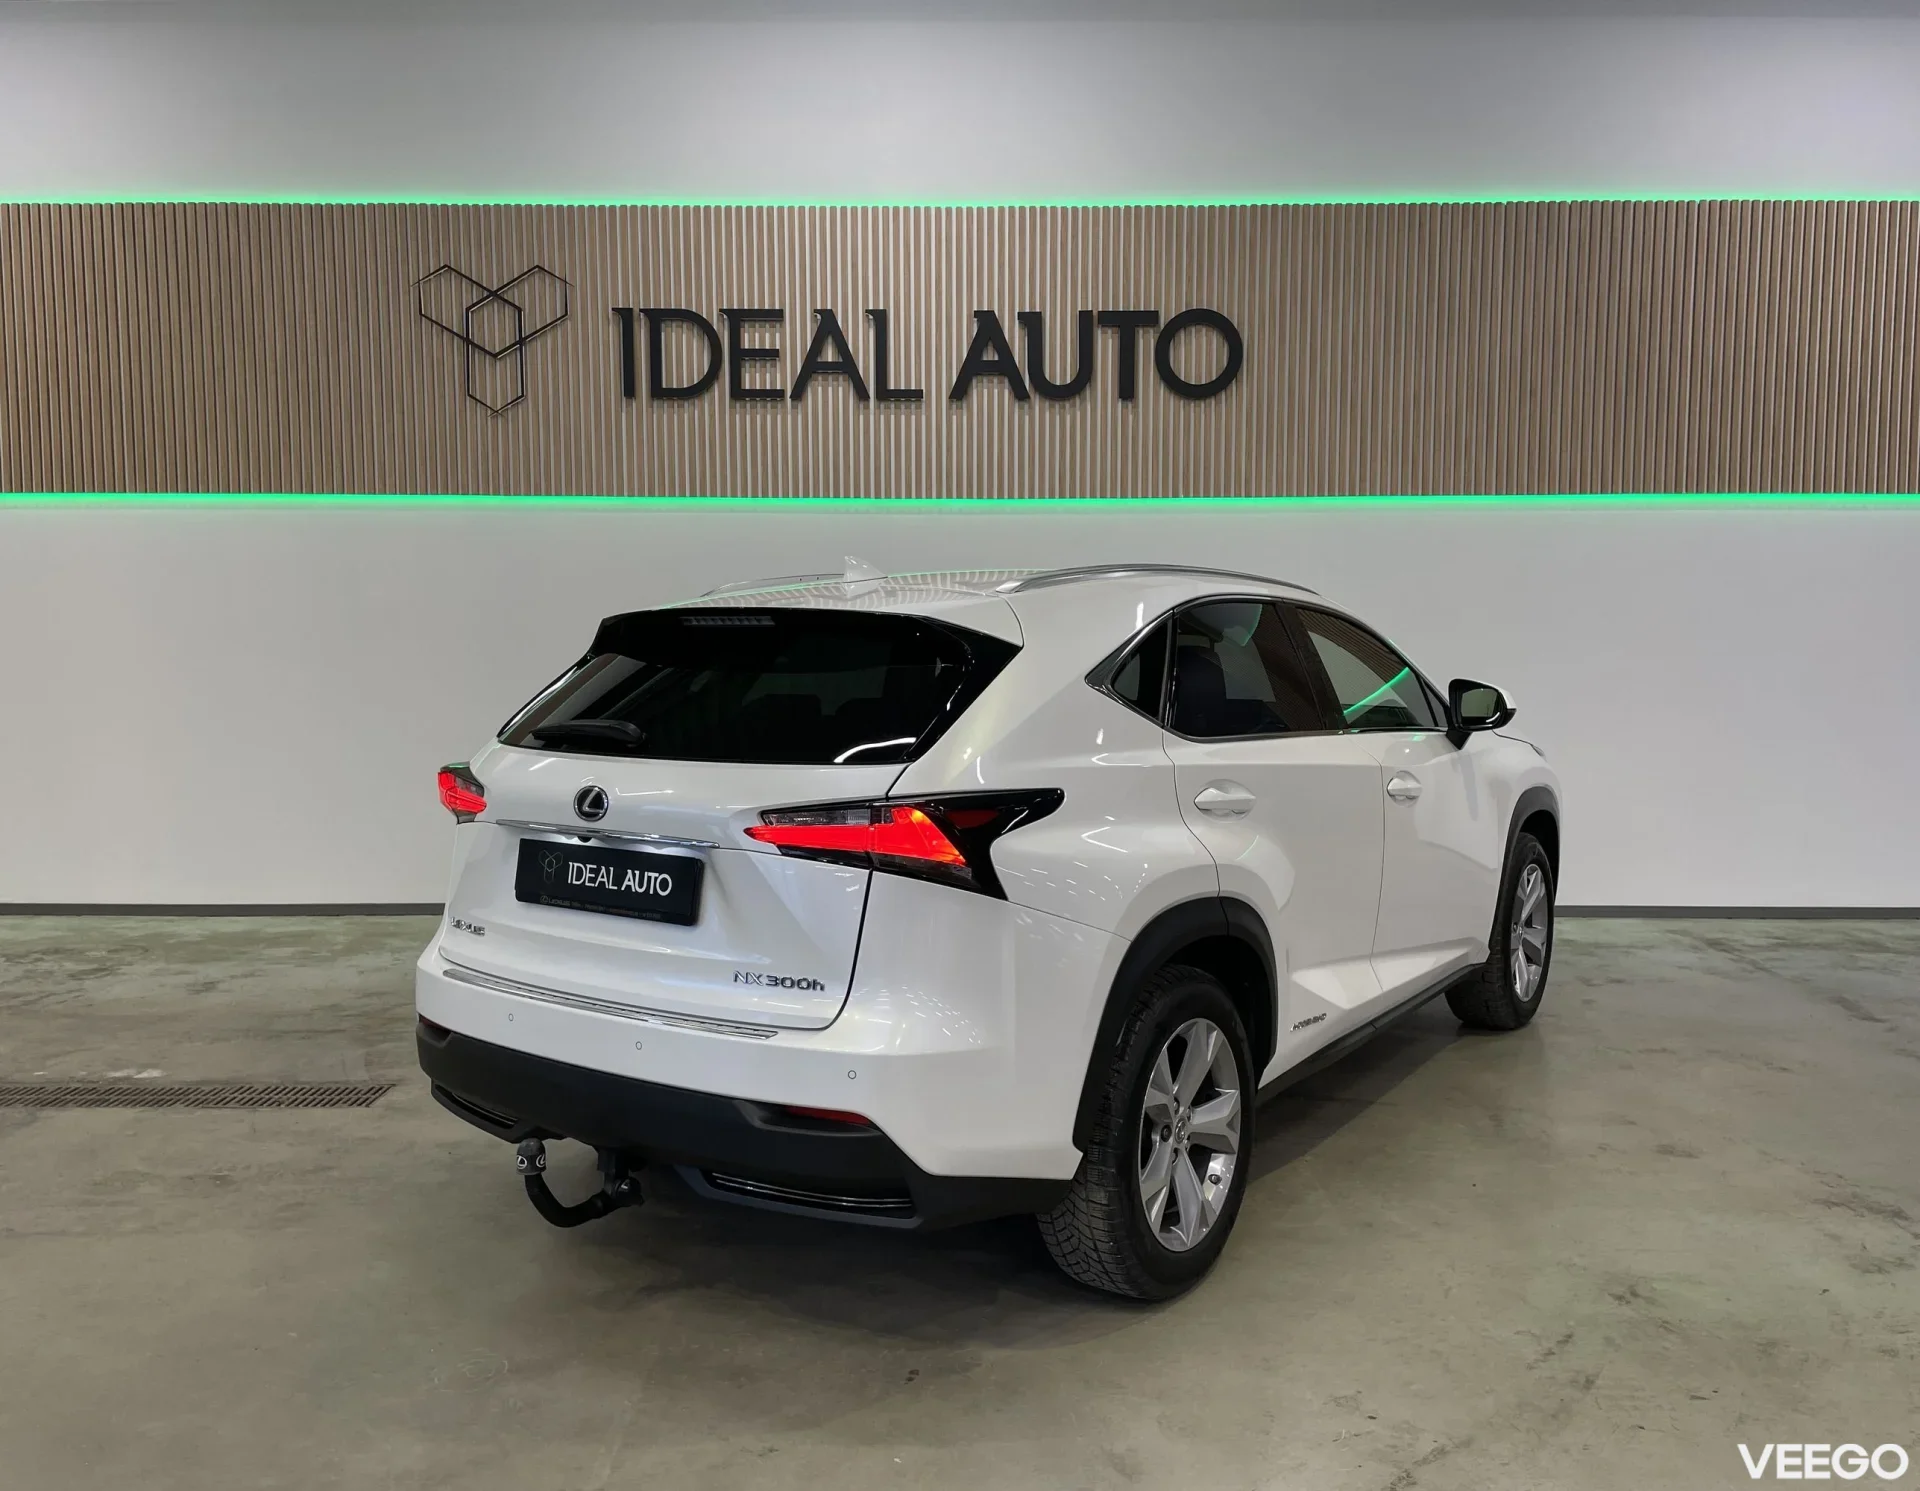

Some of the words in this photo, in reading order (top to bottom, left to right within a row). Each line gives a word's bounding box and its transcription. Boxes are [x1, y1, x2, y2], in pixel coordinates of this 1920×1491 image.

[611, 307, 924, 399] IDEAL
[948, 308, 1243, 400] AUTO
[567, 861, 618, 890] IDEAL
[621, 869, 673, 897] AUTO
